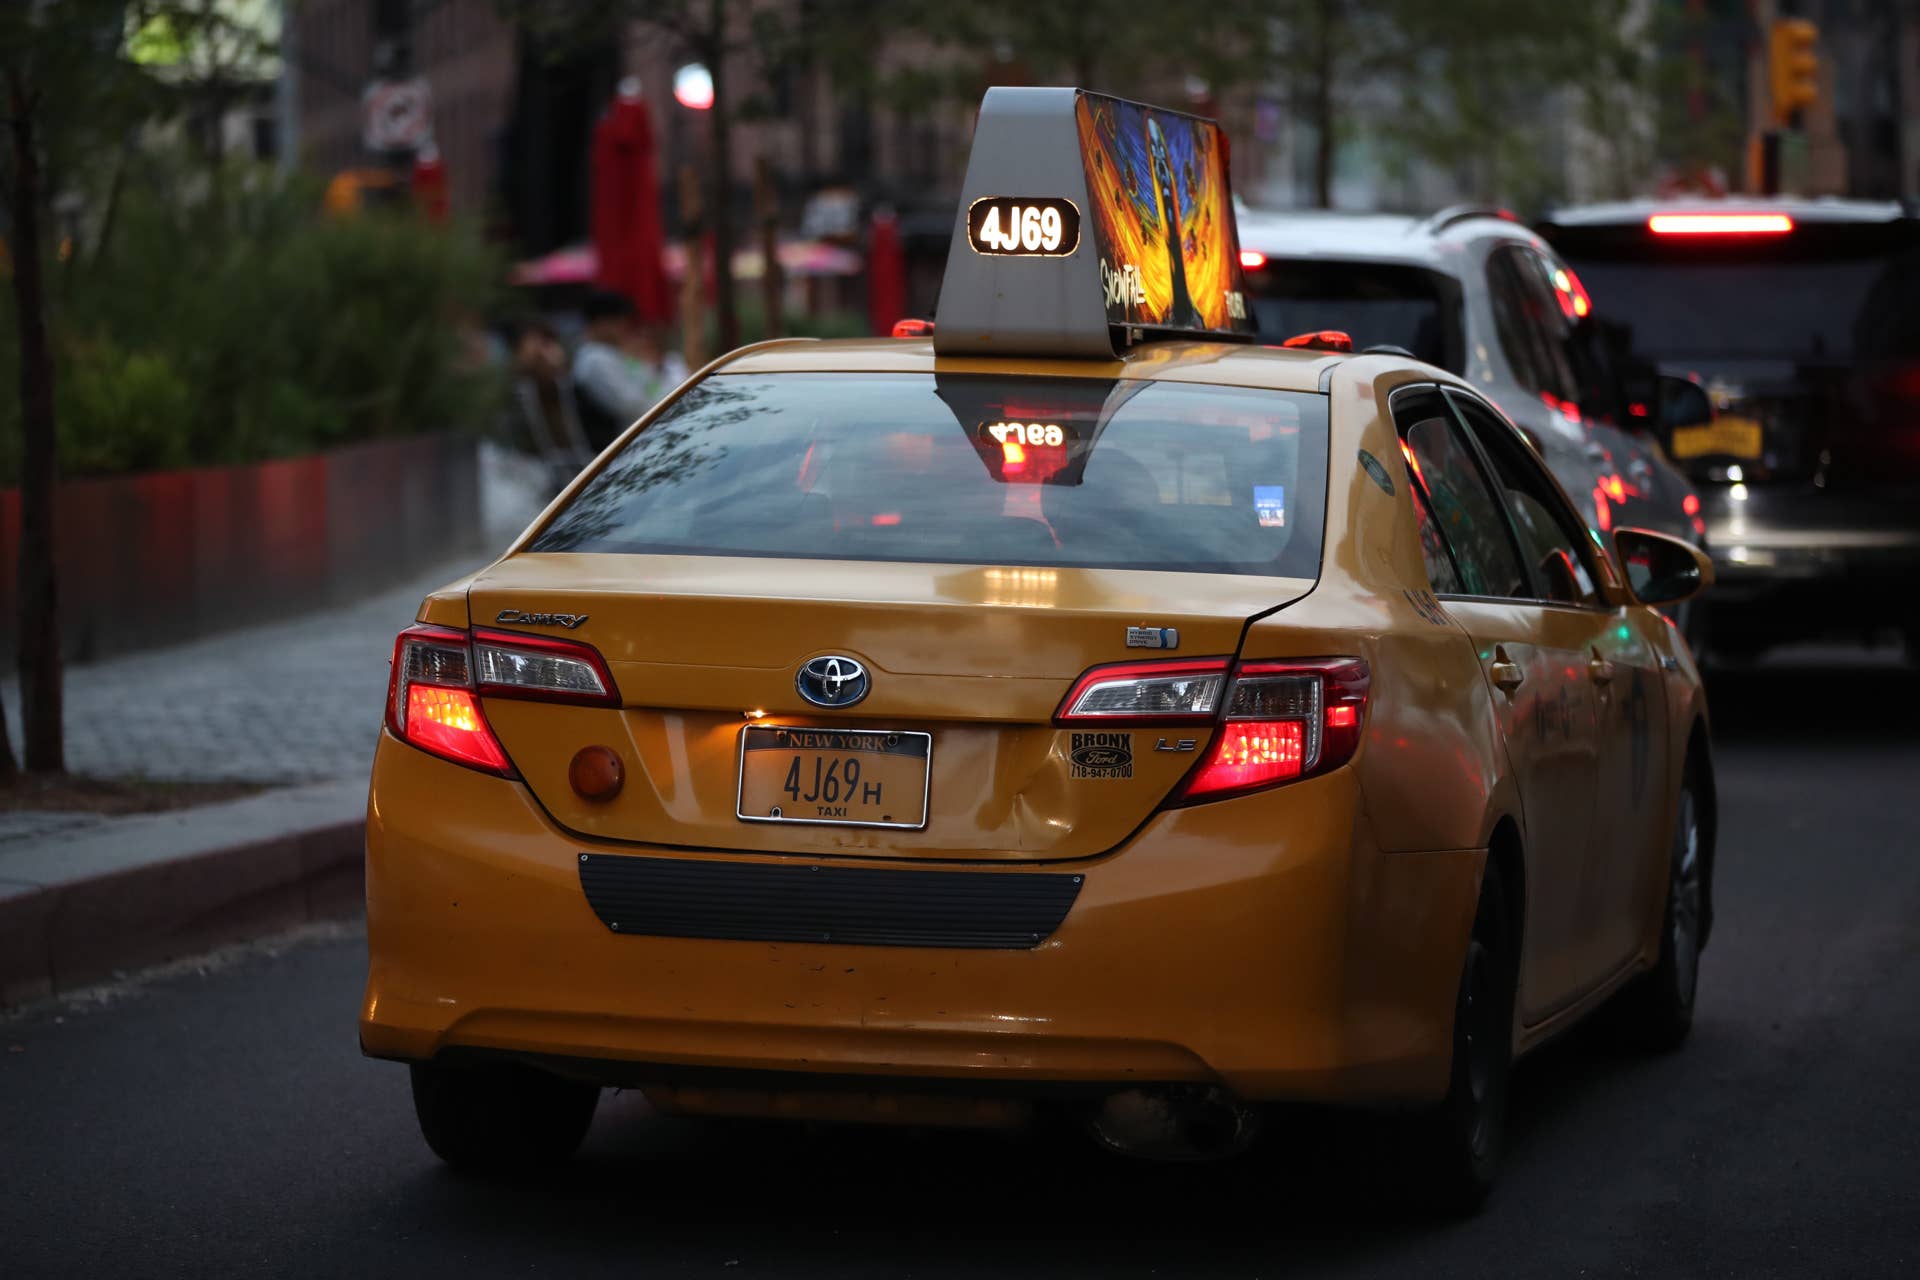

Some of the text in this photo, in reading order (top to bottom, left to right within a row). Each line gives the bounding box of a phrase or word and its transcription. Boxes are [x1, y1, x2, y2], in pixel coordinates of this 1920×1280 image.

[979, 205, 1062, 251] 4J69
[788, 732, 887, 751] NEW YORK
[1071, 733, 1132, 752] BRONX
[1155, 737, 1197, 752] LE
[1087, 750, 1119, 764] Ford
[1071, 763, 1133, 778] 718-947-0700
[816, 806, 848, 818] TAXI
